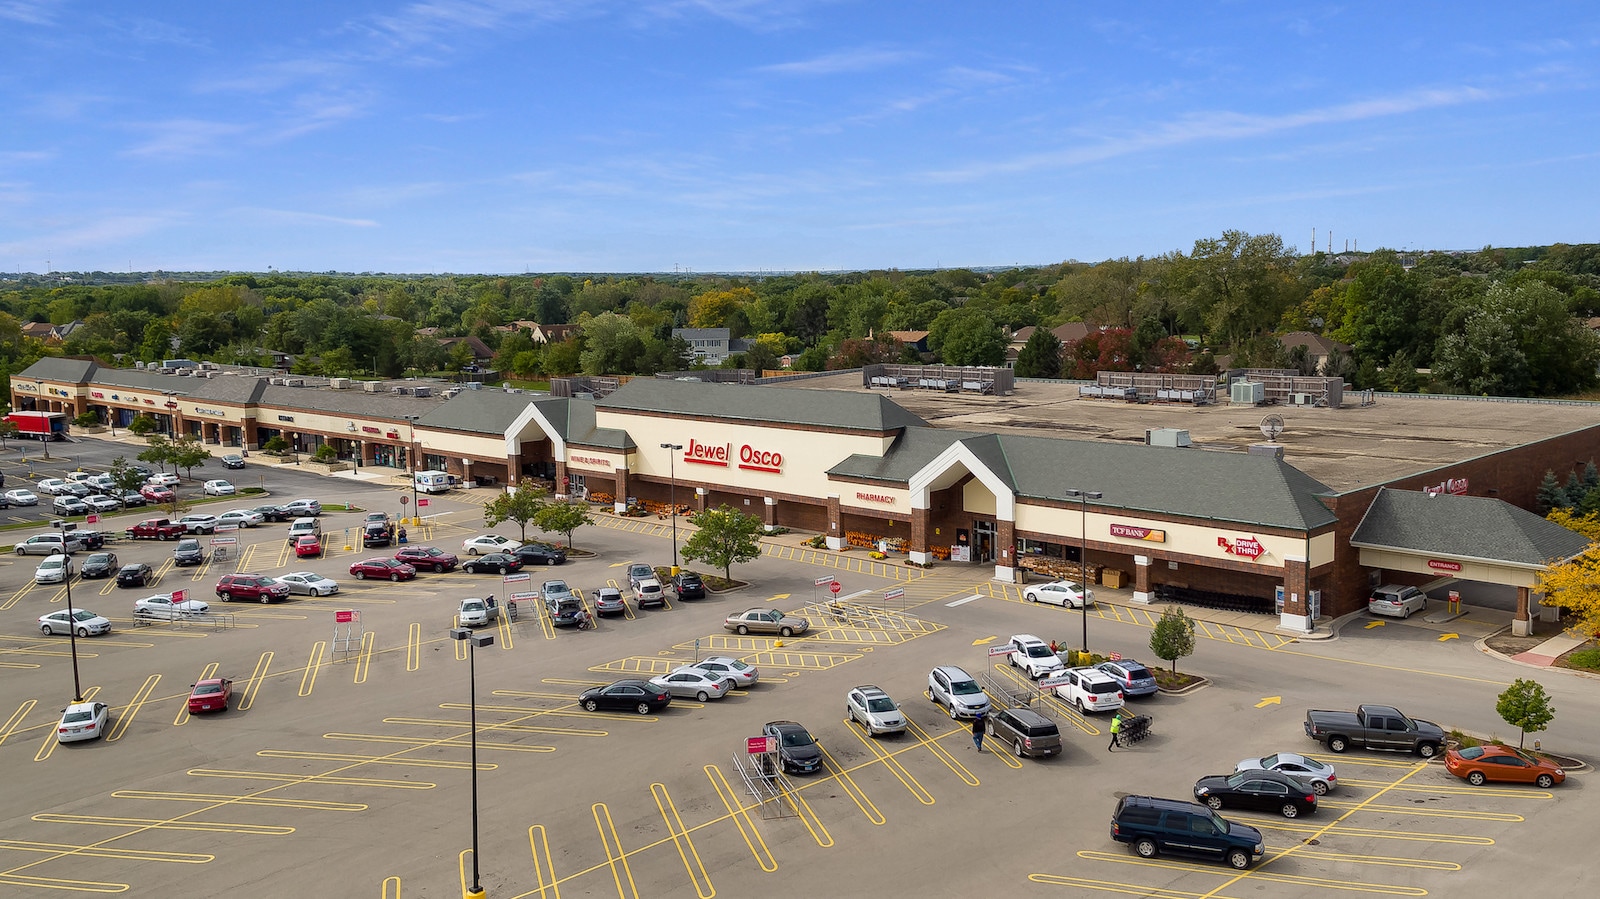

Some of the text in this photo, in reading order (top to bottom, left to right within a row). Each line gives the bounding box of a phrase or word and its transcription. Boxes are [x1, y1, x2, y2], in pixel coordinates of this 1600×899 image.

[684, 438, 783, 467] Jewel Osco
[856, 492, 895, 505] PHARMACY
[1111, 526, 1125, 535] TCF
[1125, 528, 1145, 538] BANK
[1236, 540, 1259, 549] DRIVE
[1237, 547, 1259, 556] THRU
[1429, 561, 1460, 570] ENTRANCE
